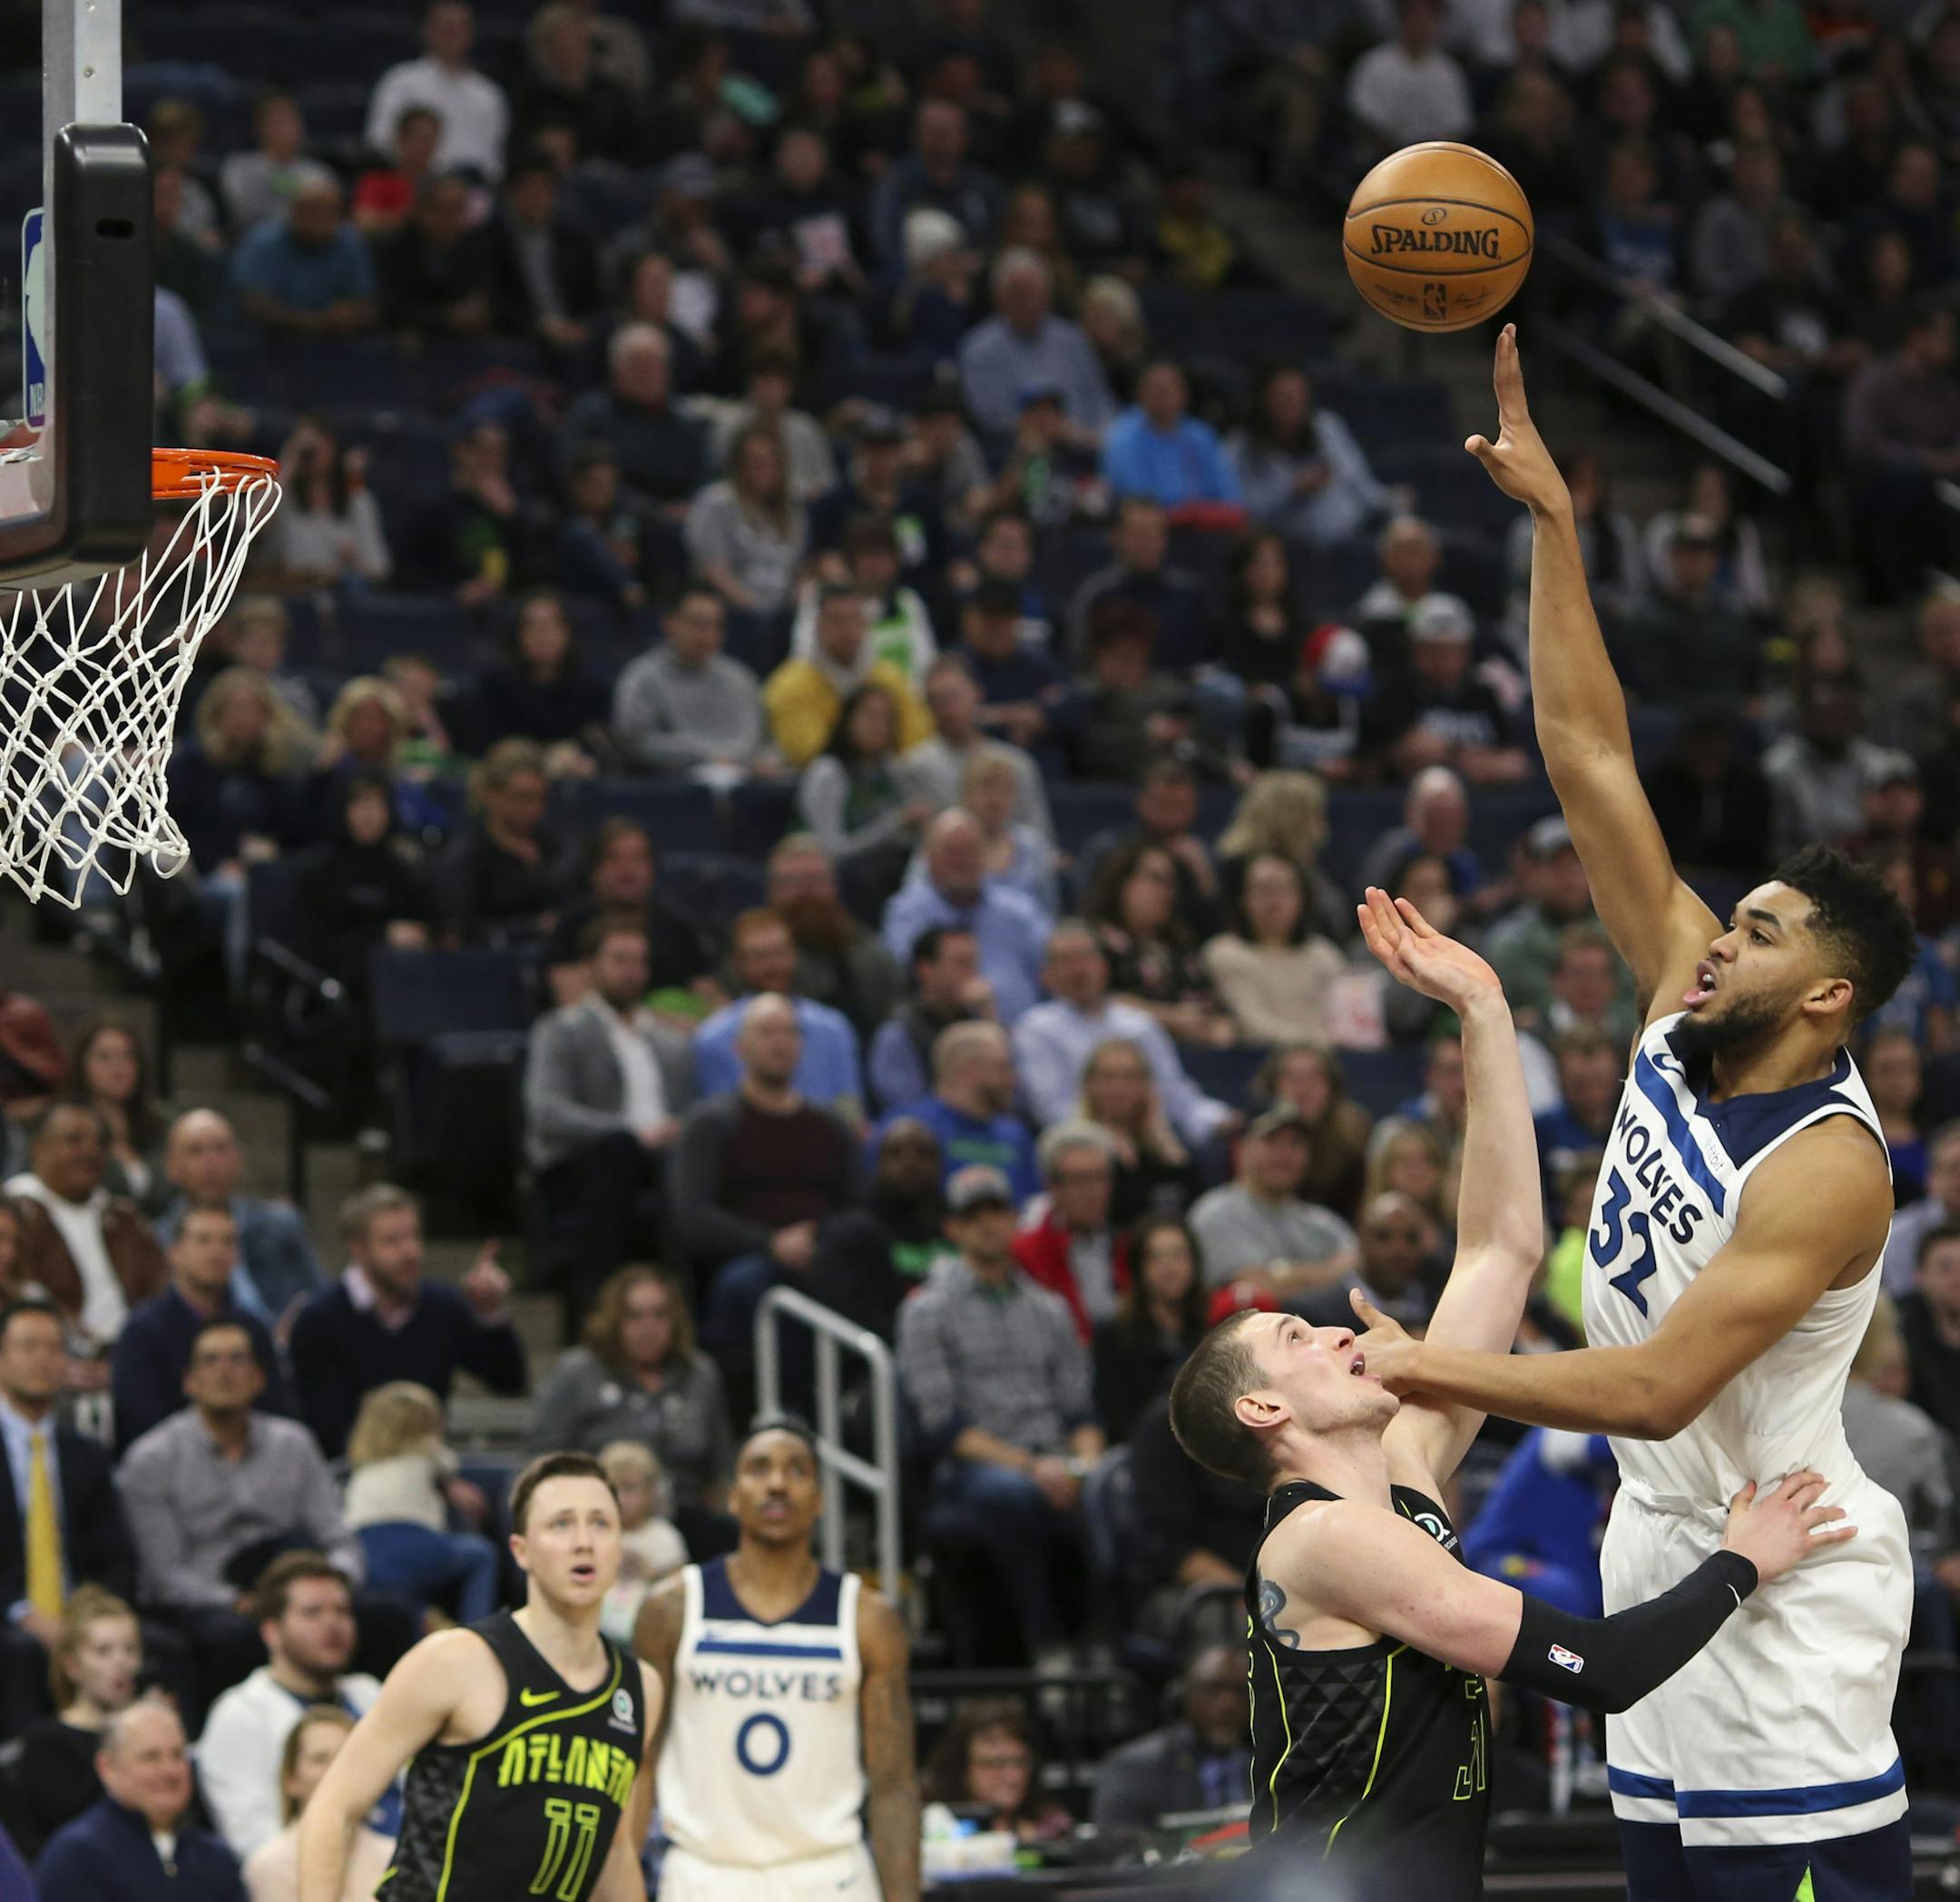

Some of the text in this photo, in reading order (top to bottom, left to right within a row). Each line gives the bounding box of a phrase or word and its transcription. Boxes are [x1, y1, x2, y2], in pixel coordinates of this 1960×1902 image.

[1371, 224, 1500, 260] SPALDING
[29, 382, 44, 417] NB
[1616, 1096, 1703, 1244] WOLVES
[1590, 1164, 1658, 1320] 32
[689, 1669, 843, 1701] WOLVES
[497, 1733, 636, 1811] ATLANTA
[736, 1712, 790, 1777] 0
[528, 1797, 601, 1901] 11
